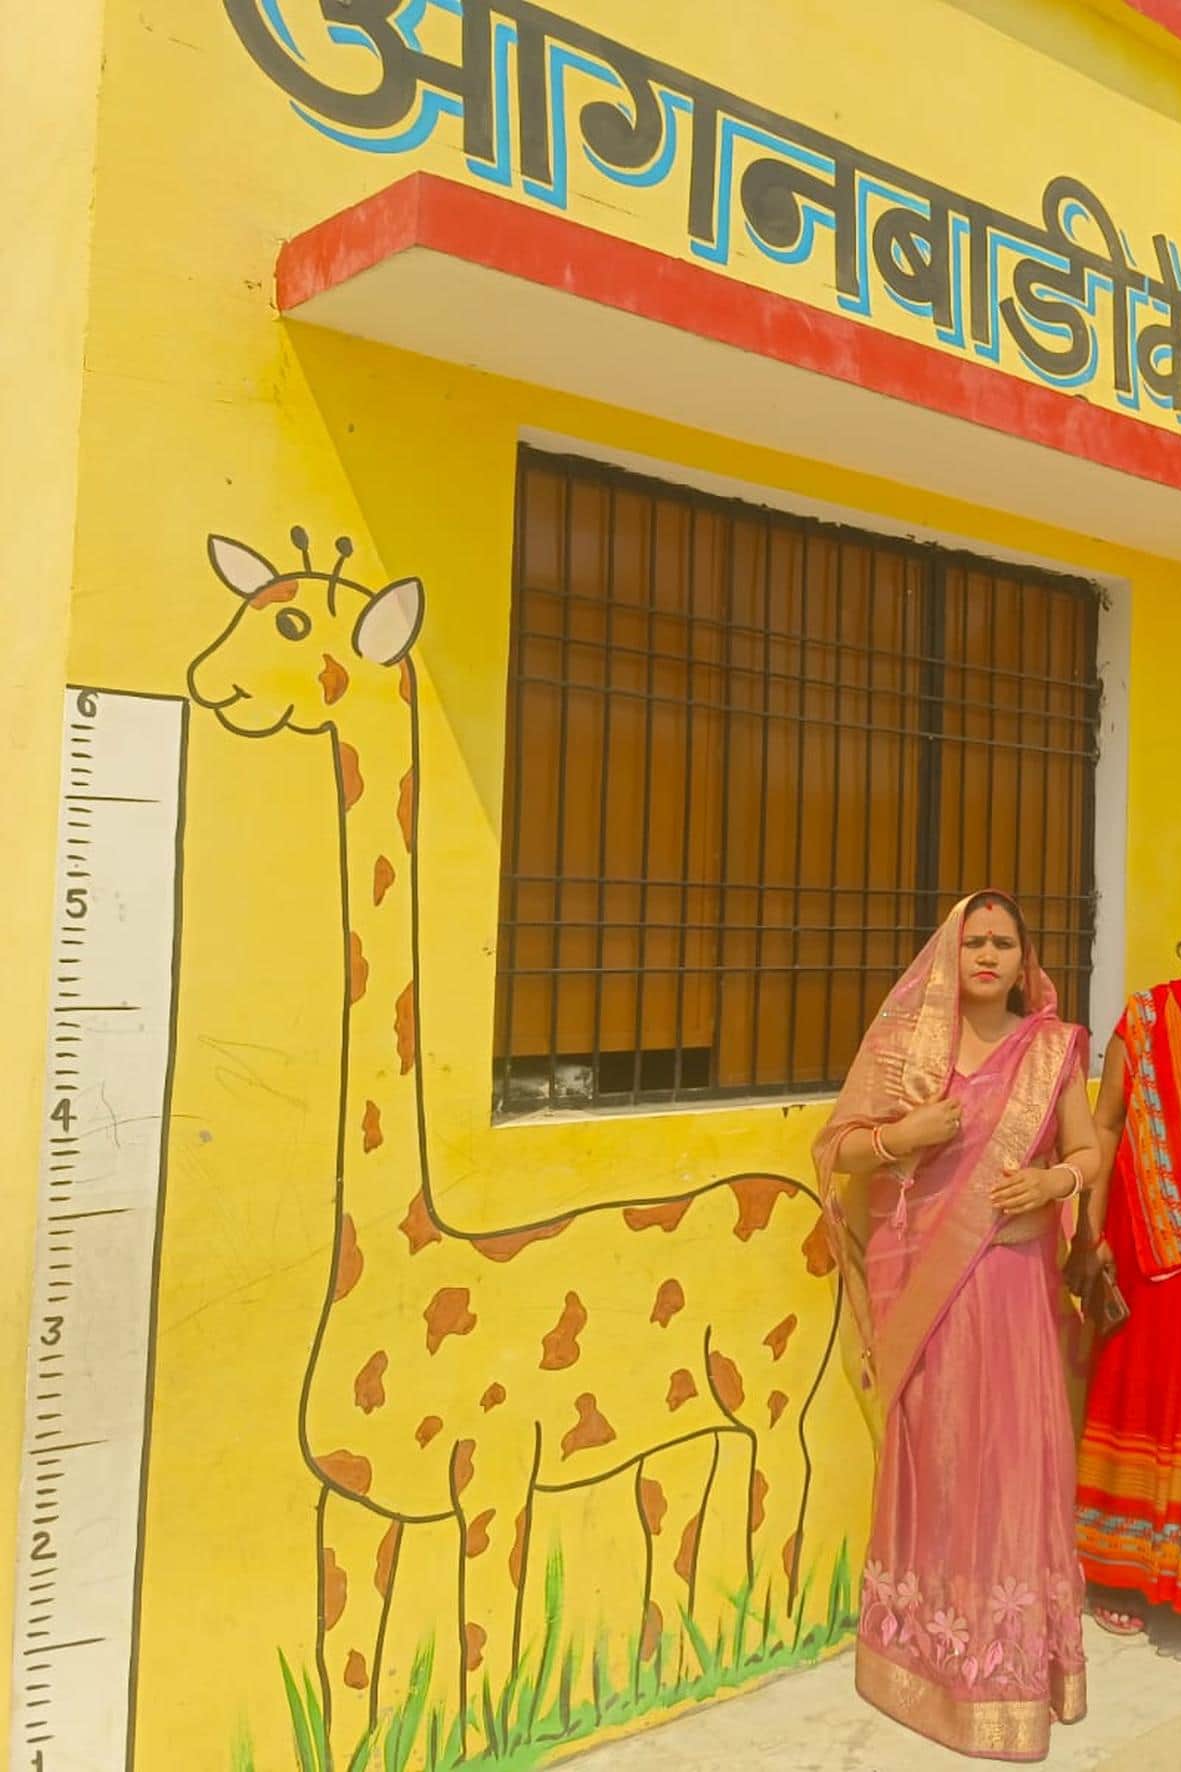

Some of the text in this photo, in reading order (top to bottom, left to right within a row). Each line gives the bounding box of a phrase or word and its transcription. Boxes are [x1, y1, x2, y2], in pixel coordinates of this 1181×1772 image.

[75, 686, 99, 719] 6
[65, 888, 89, 919] 5
[50, 1097, 78, 1132] 4
[40, 1315, 64, 1346] 3
[30, 1531, 57, 1560] 2
